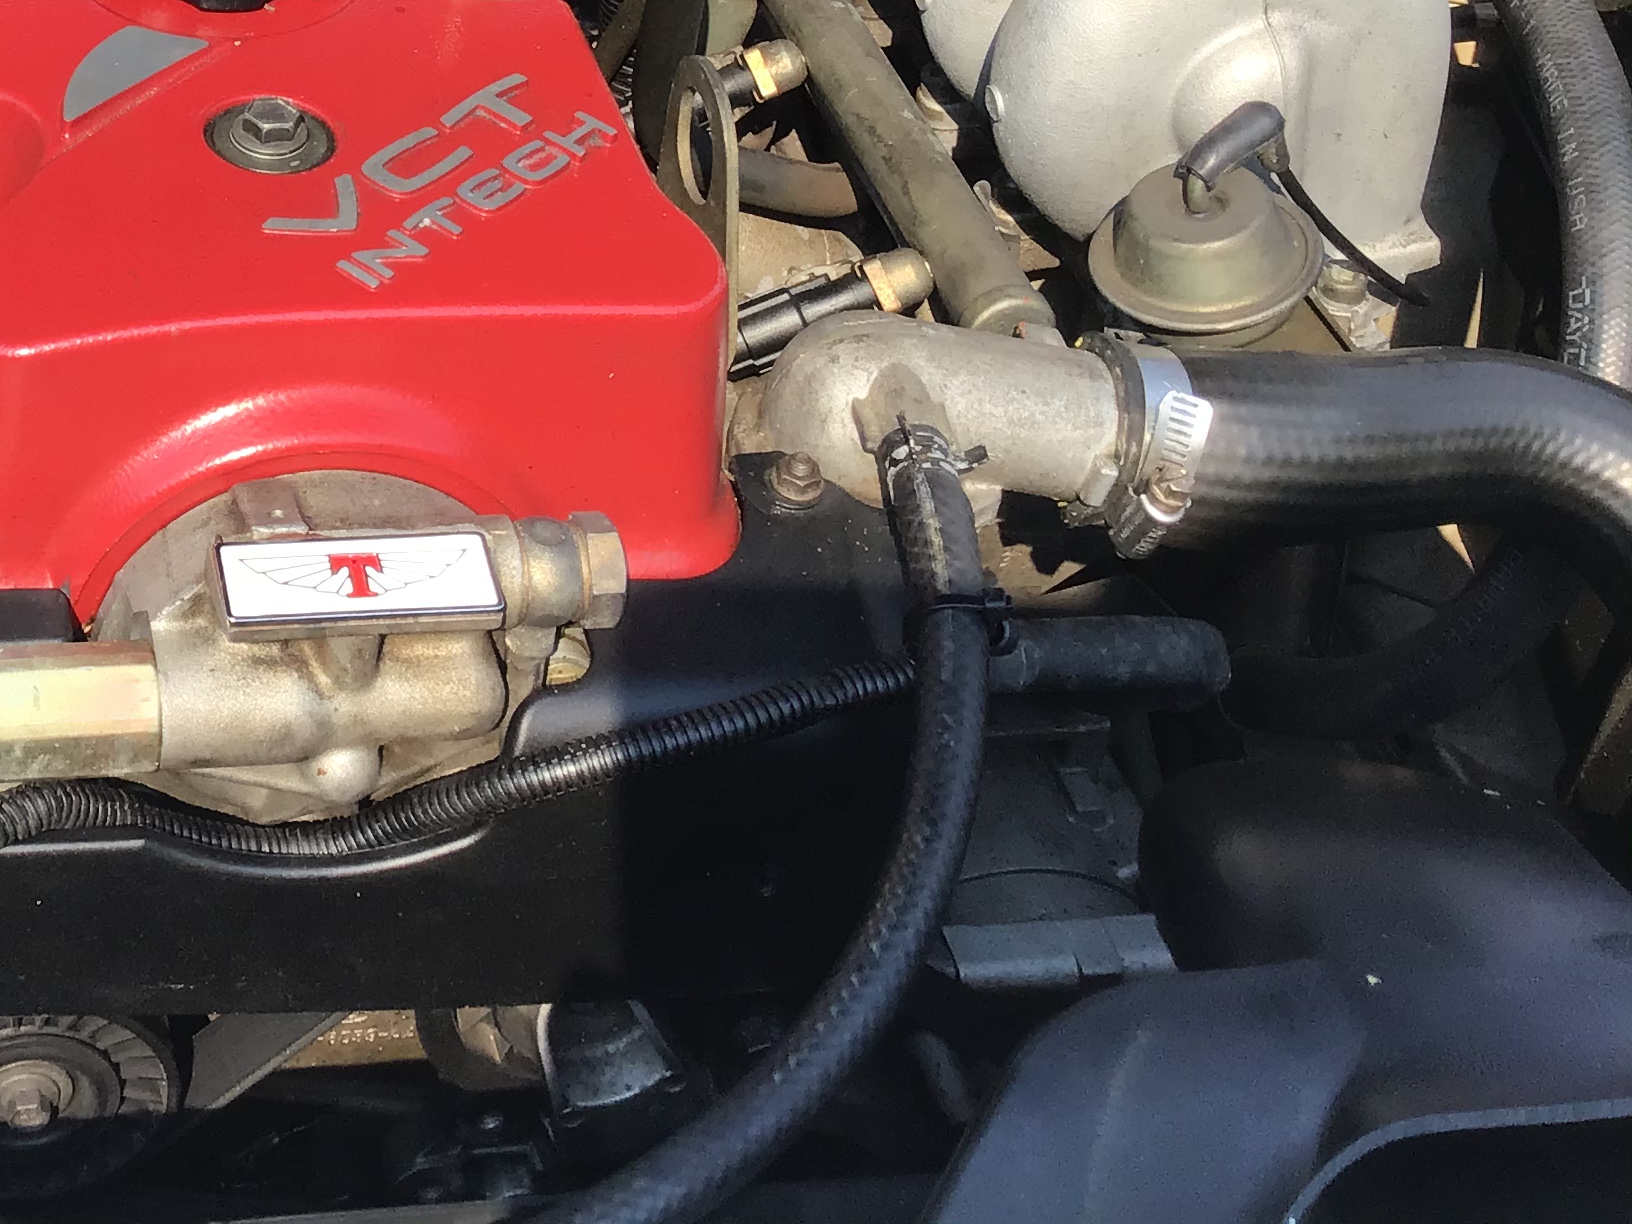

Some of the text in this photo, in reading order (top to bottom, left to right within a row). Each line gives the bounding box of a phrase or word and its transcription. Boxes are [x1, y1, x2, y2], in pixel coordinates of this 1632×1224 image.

[261, 72, 534, 234] VCT
[335, 109, 618, 289] INTECH
[1568, 176, 1589, 232] USA
